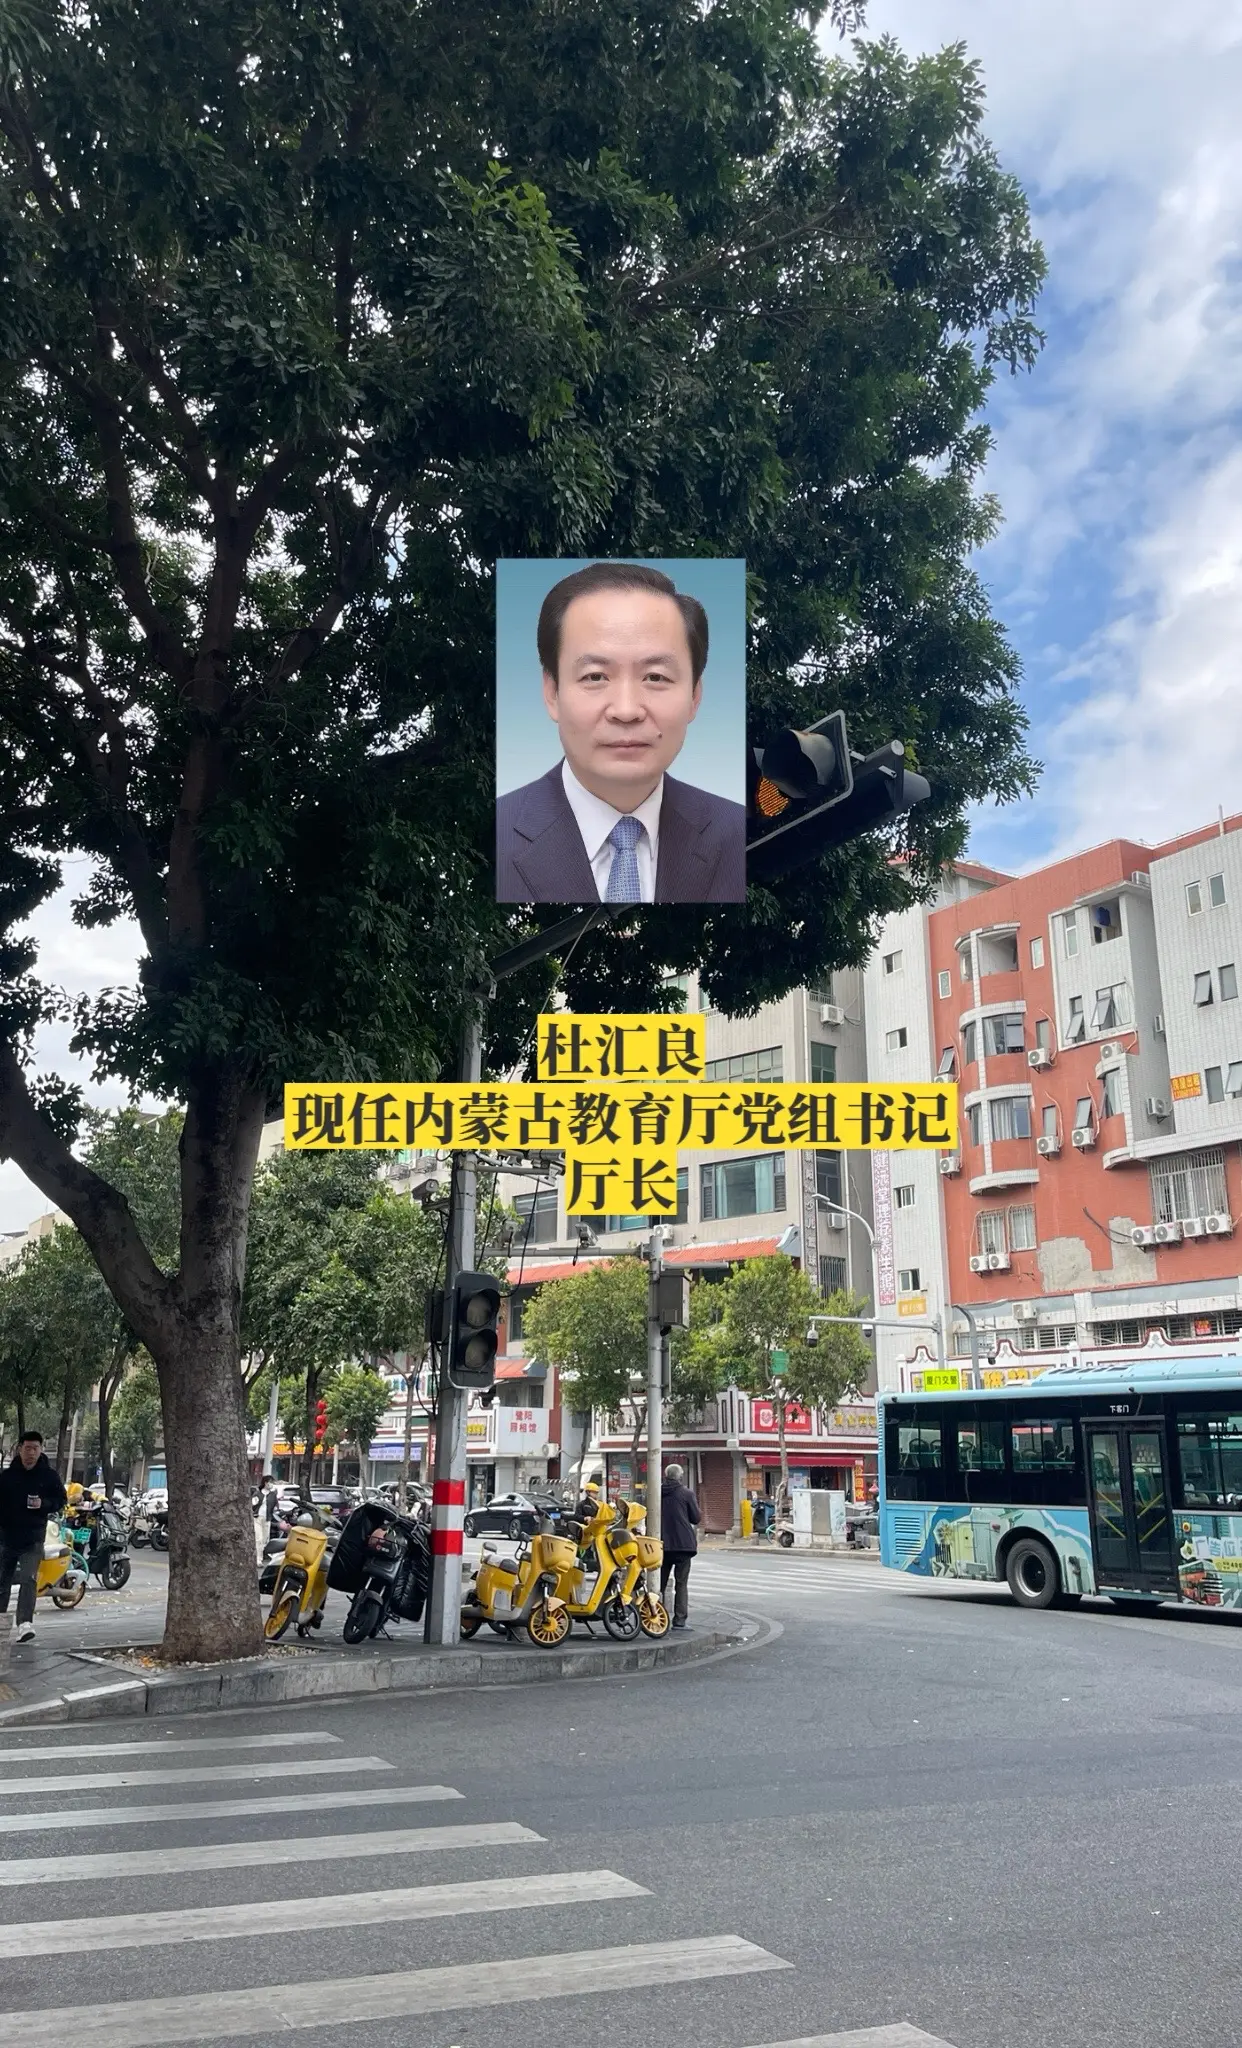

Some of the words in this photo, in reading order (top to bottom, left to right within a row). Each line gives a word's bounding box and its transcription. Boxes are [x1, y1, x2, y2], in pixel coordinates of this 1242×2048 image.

[926, 1375, 957, 1385] 厦门交警
[1109, 1404, 1129, 1413] 下客门
